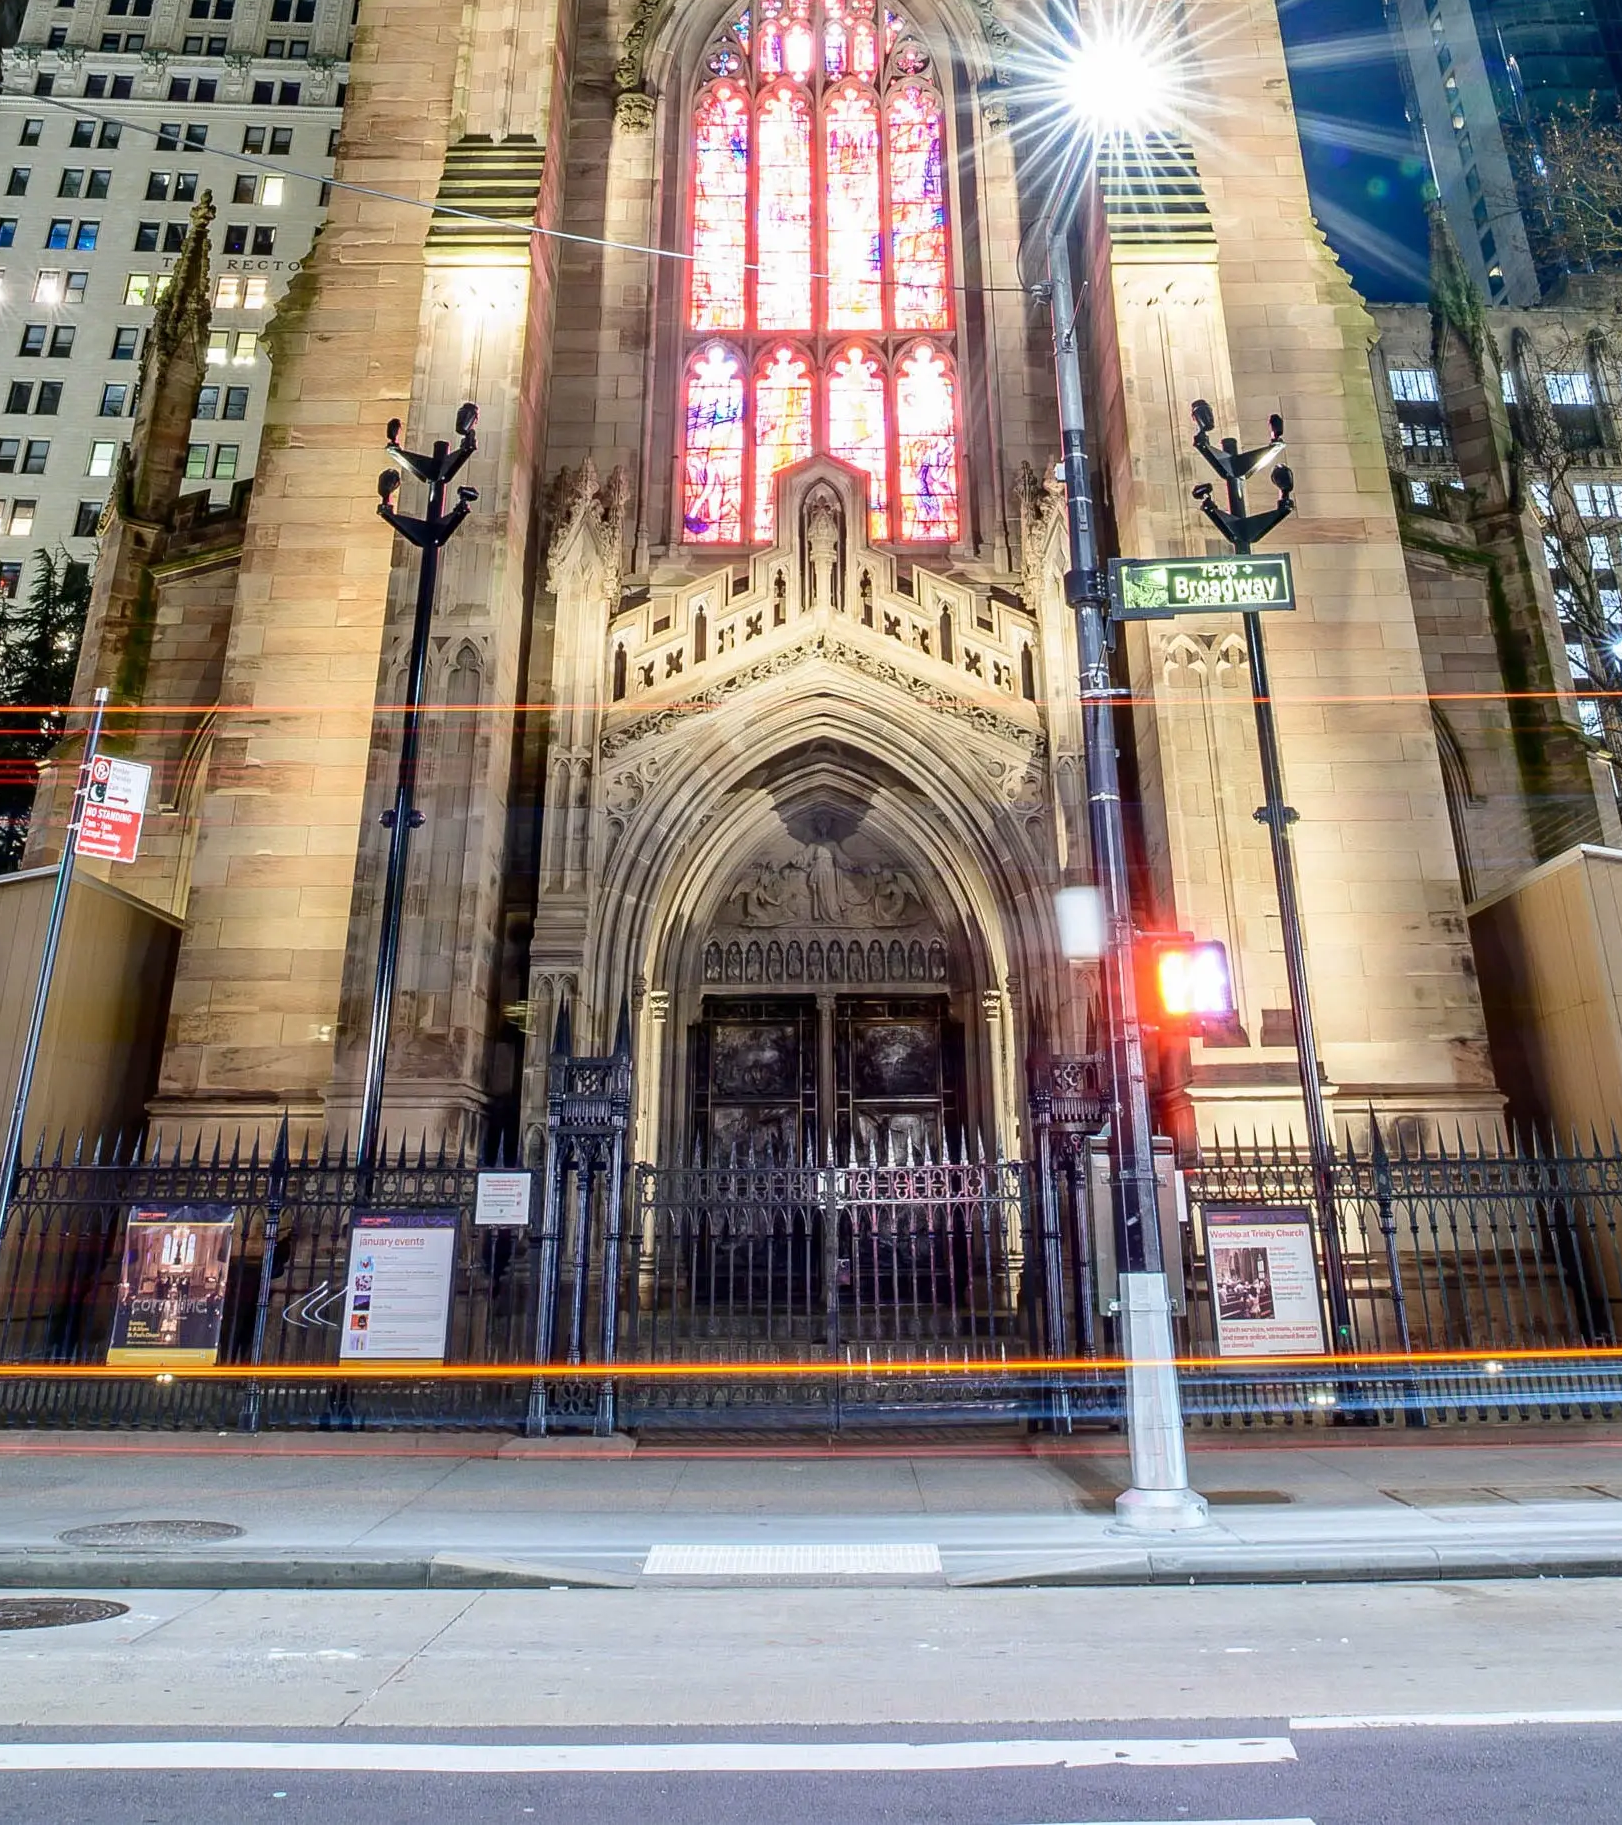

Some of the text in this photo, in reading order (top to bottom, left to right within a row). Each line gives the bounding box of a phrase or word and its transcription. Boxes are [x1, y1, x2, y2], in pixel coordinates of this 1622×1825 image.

[227, 259, 301, 272] RECTO
[1200, 565, 1238, 578] 75-109
[1174, 576, 1278, 602] Broadway
[86, 806, 132, 824] NO STANDING
[1210, 1230, 1242, 1240] Worship
[1250, 1229, 1275, 1239] Trinity
[1276, 1229, 1305, 1238] Church
[359, 1236, 425, 1247] january events
